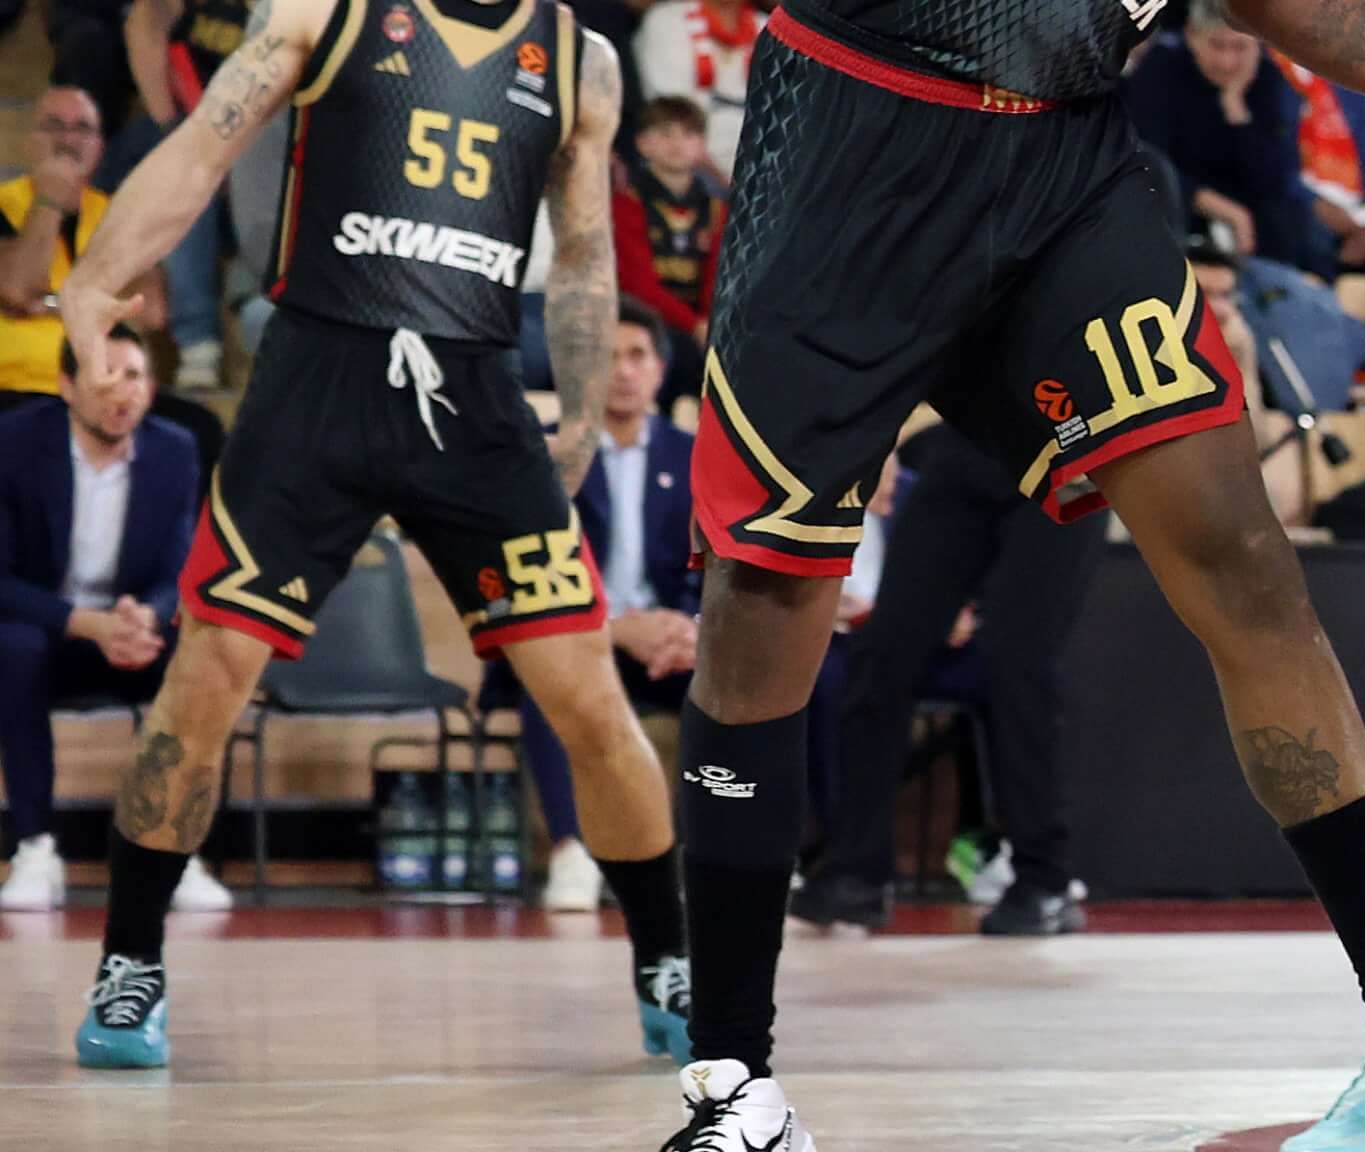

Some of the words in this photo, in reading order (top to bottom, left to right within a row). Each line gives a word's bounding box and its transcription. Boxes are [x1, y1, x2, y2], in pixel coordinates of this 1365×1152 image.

[404, 107, 500, 201] 55
[333, 211, 525, 289] SKWEEK
[1084, 297, 1192, 416] 10
[501, 528, 594, 615] 55
